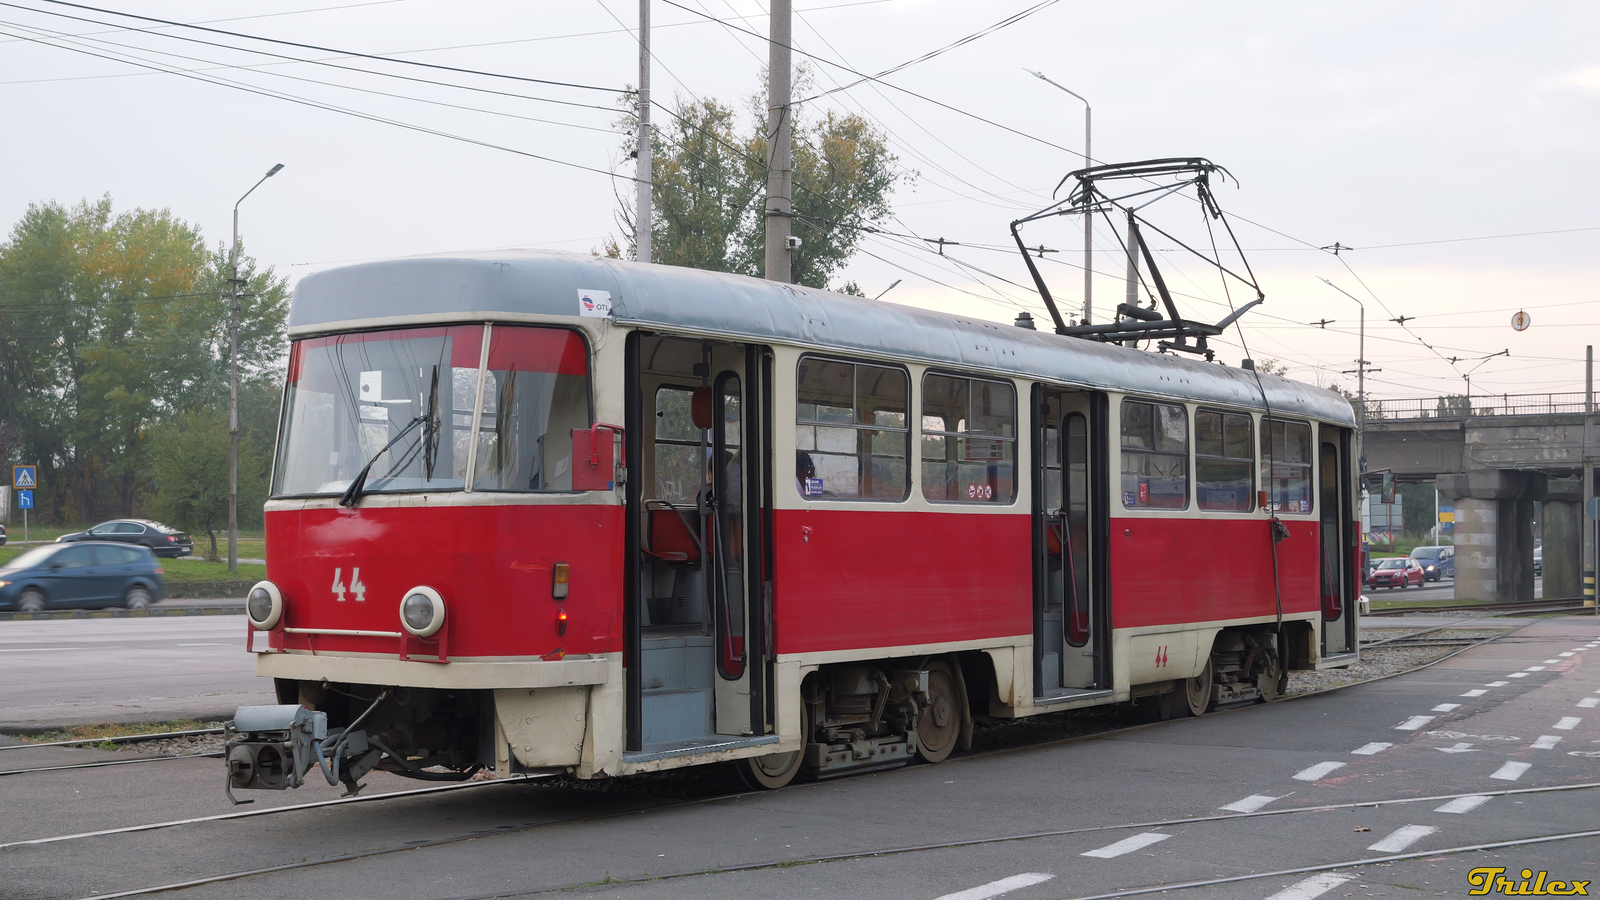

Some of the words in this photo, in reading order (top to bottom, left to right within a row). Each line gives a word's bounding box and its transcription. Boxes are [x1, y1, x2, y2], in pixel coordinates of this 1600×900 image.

[596, 303, 609, 311] OTL
[331, 567, 366, 602] 44
[1155, 645, 1168, 668] 44
